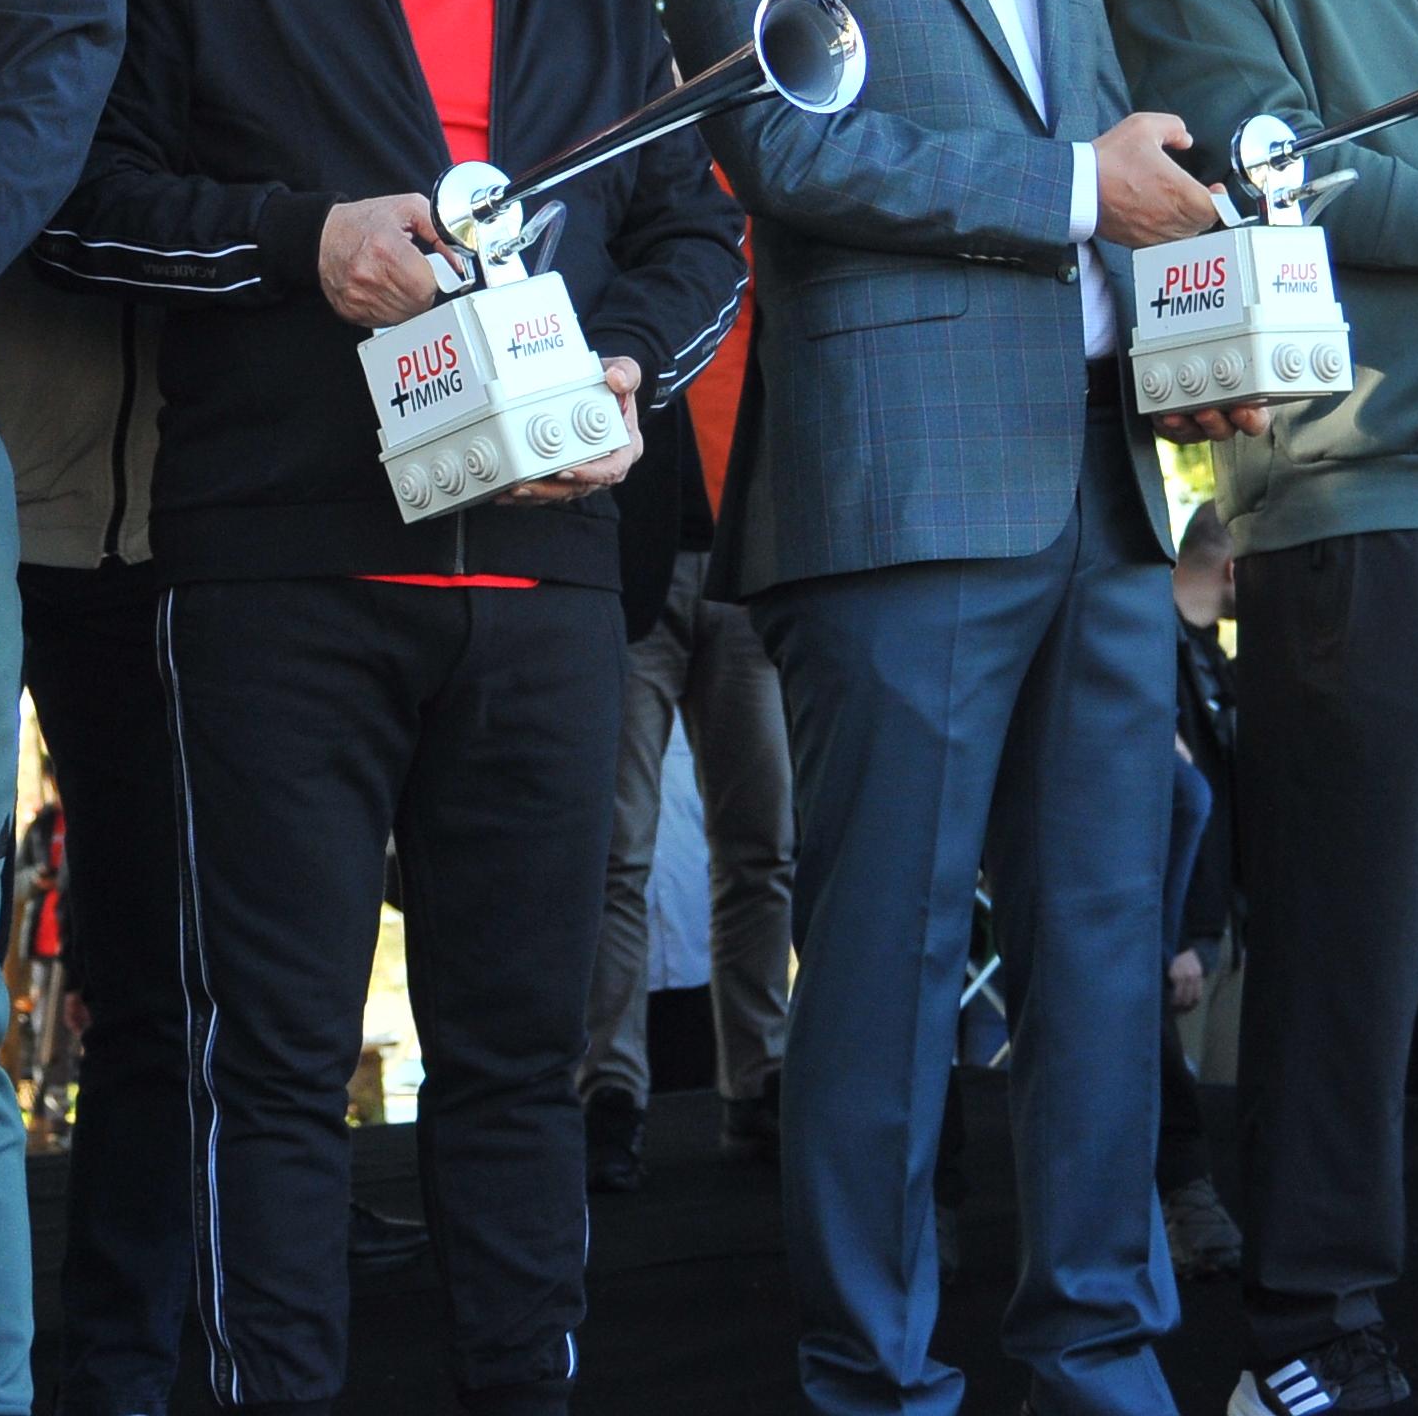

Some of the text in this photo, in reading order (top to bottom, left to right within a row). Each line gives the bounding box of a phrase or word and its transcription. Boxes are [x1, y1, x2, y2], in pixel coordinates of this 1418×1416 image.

[1165, 257, 1226, 295] PLUS
[1281, 263, 1318, 280] PLUS
[514, 313, 561, 343] PLUS
[397, 334, 458, 390] PLUS
